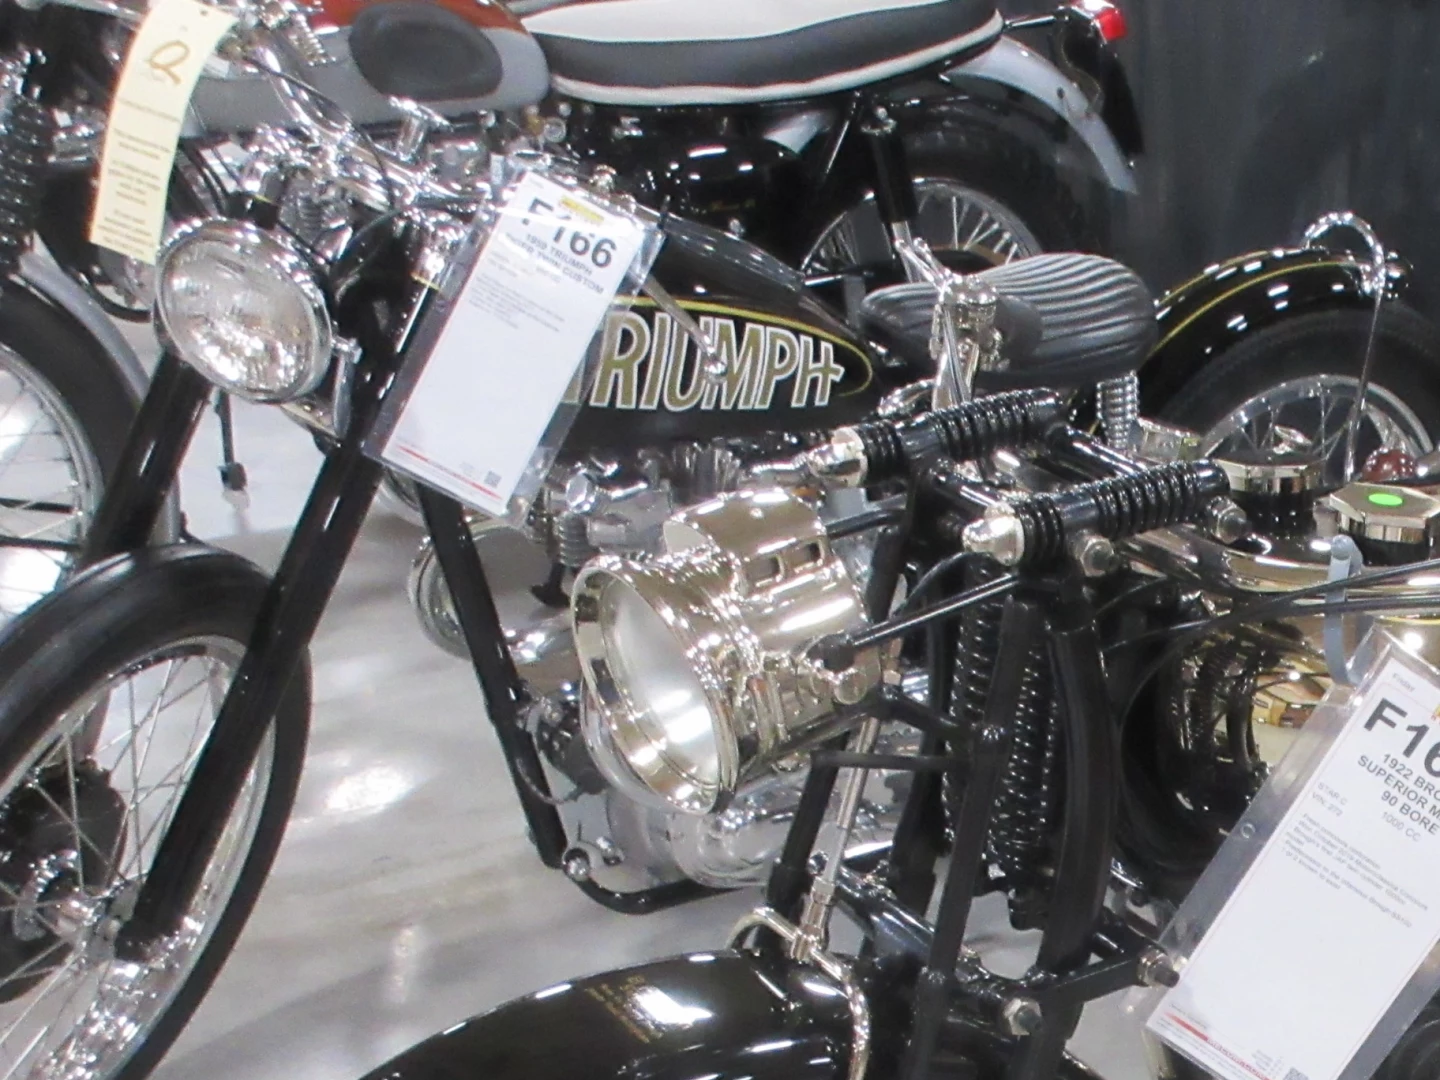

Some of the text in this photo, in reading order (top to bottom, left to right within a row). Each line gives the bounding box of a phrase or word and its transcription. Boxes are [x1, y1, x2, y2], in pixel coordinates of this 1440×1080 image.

[520, 197, 621, 270] F166
[547, 246, 593, 275] TRIUMPH
[561, 266, 604, 294] CUSTOM
[1356, 754, 1429, 809] SUPERIOR
[1380, 752, 1414, 780] 1922
[1379, 790, 1440, 835] 90 BORE
[1380, 810, 1422, 842] 1000 CC
